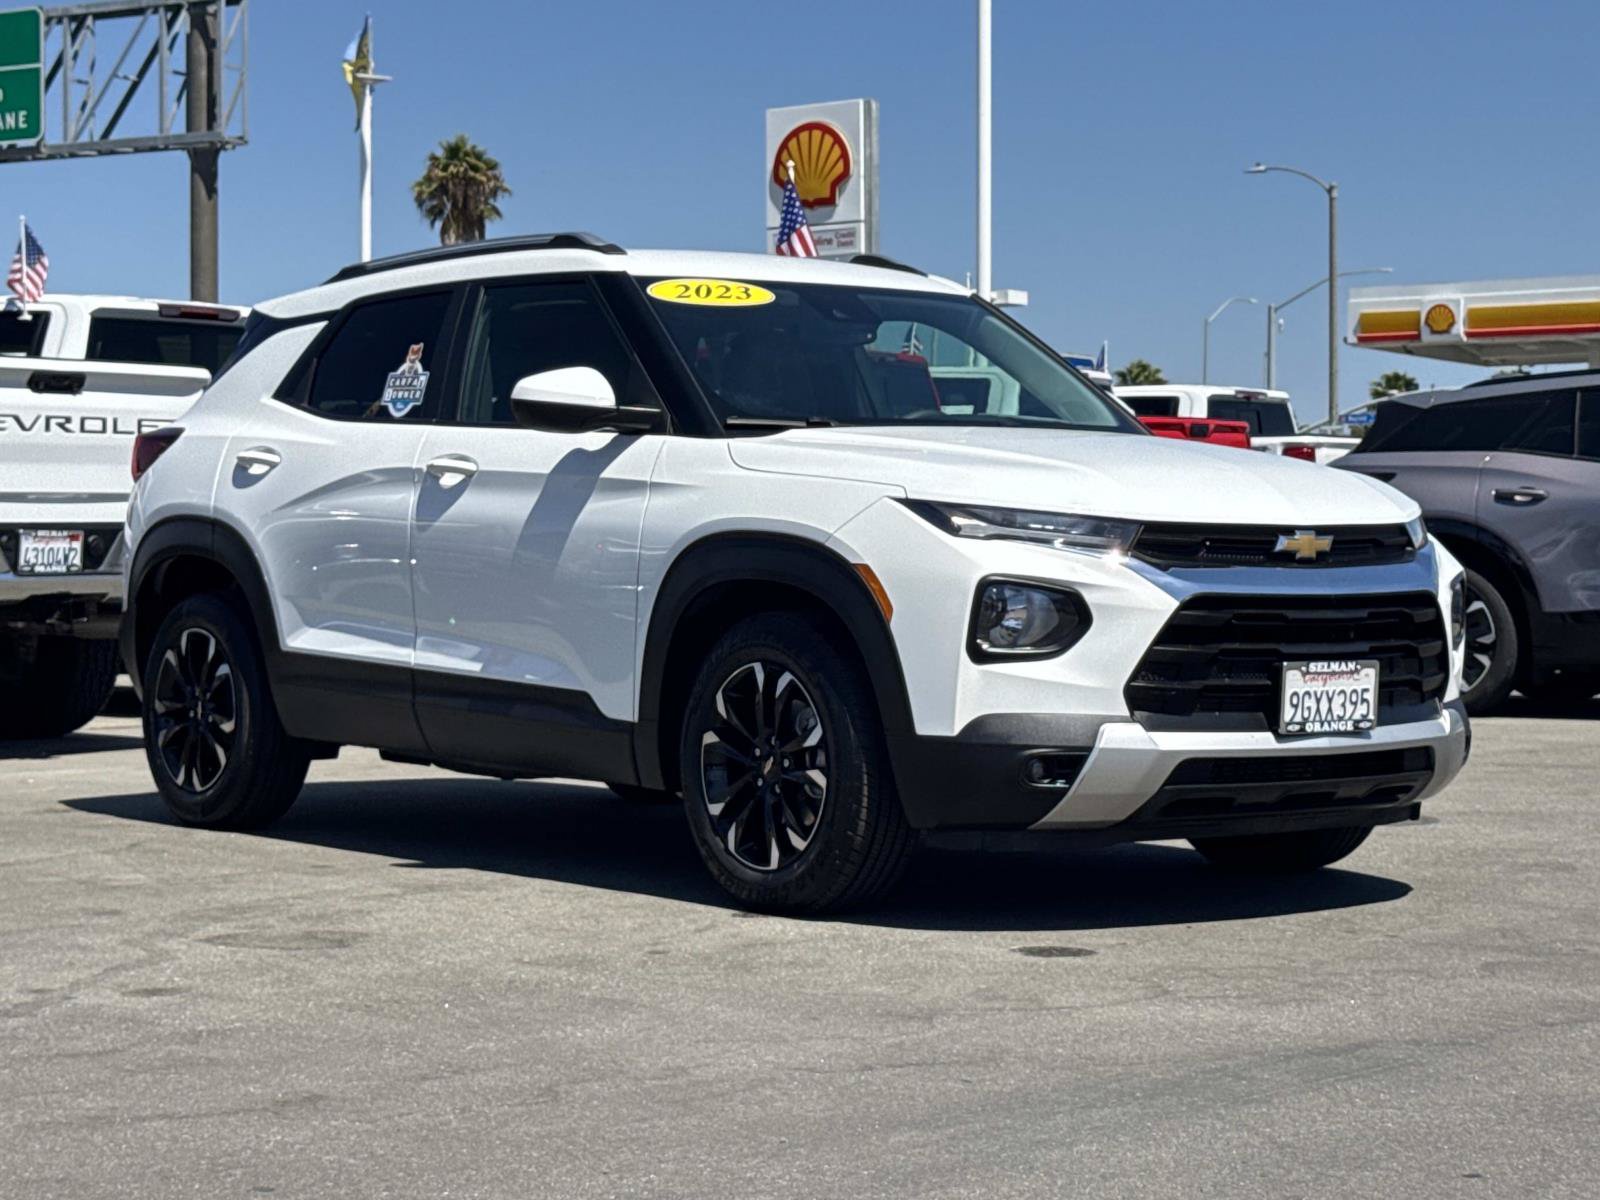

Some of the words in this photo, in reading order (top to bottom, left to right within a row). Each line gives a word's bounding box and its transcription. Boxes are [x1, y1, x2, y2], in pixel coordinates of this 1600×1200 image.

[674, 284, 752, 300] 2023
[1308, 661, 1357, 673] SELMAN
[1289, 687, 1371, 722] 9GXX395
[1305, 721, 1354, 733] ORANGE
